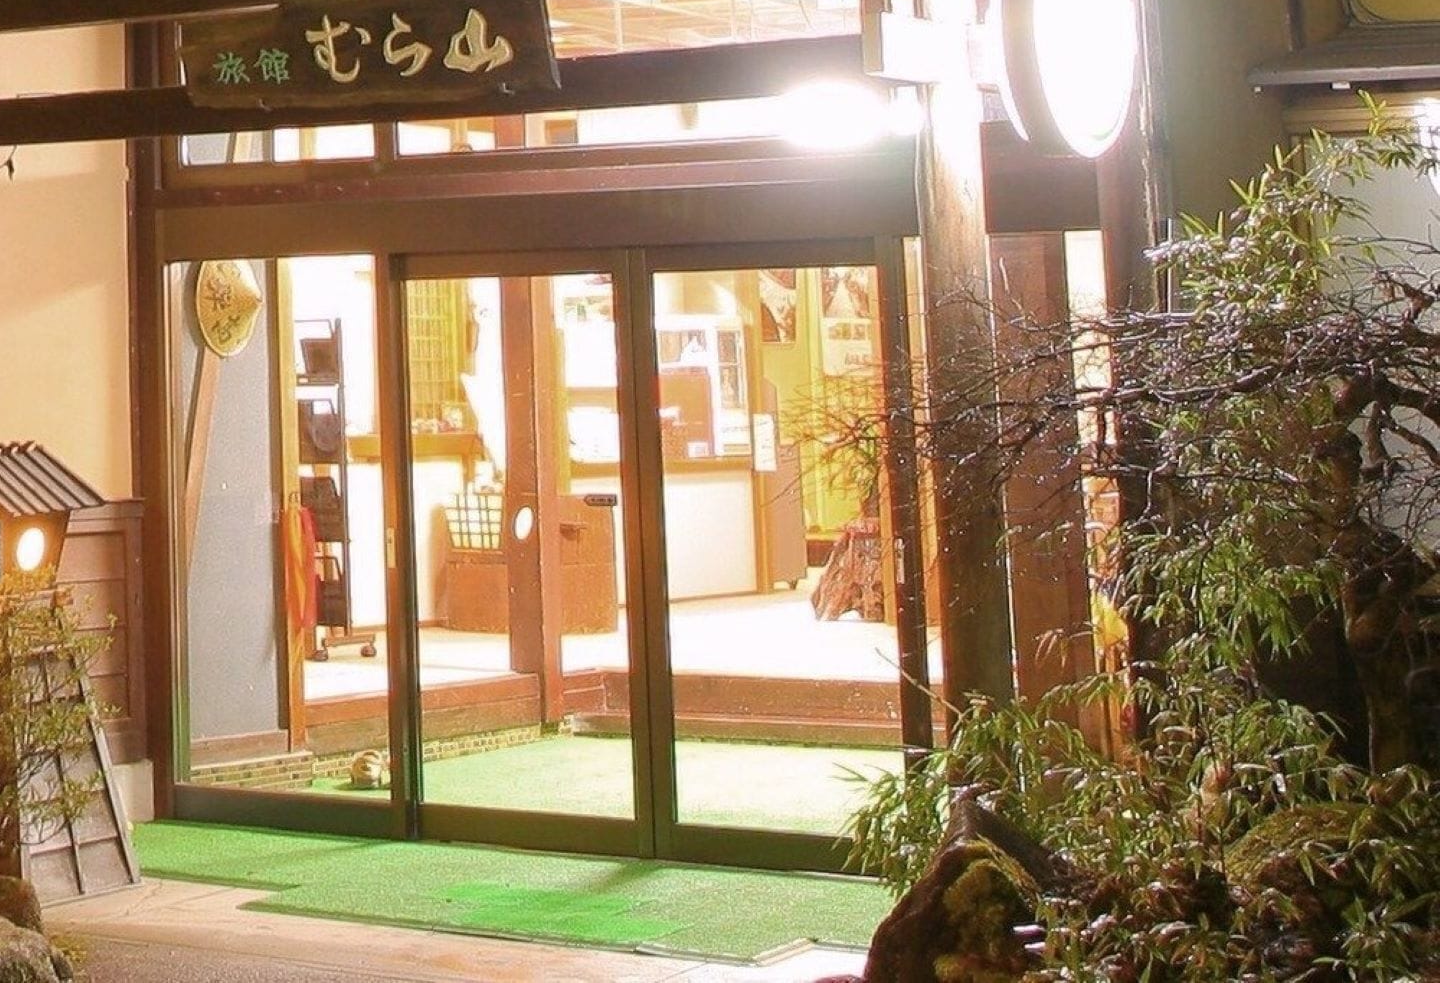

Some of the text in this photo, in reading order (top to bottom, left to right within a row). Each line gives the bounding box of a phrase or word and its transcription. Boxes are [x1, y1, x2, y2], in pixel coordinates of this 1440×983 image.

[213, 9, 514, 84] 旅館 むら山
